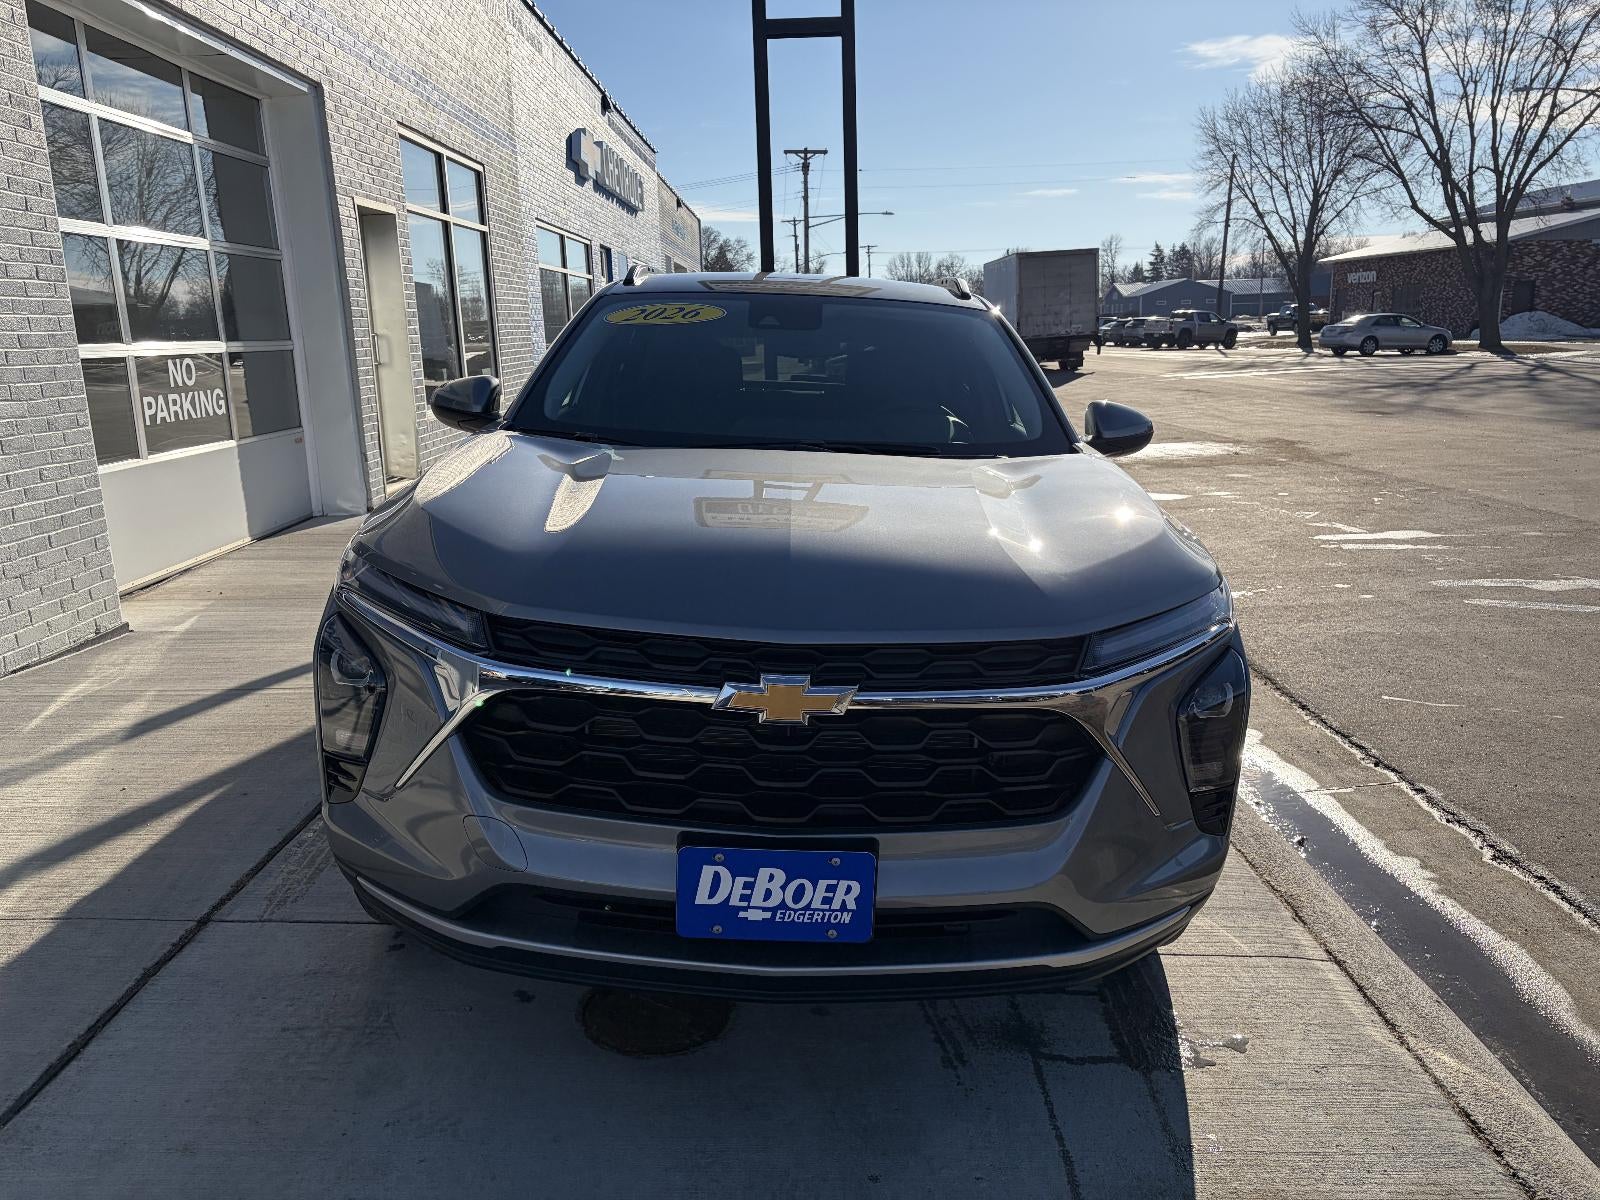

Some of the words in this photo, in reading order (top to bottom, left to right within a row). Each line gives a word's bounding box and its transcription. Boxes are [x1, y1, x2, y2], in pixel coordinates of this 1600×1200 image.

[1347, 269, 1377, 284] verizon
[621, 306, 705, 321] 2026
[167, 357, 196, 388] NO
[142, 388, 226, 426] PARKING
[775, 909, 853, 925] EDGERTON
